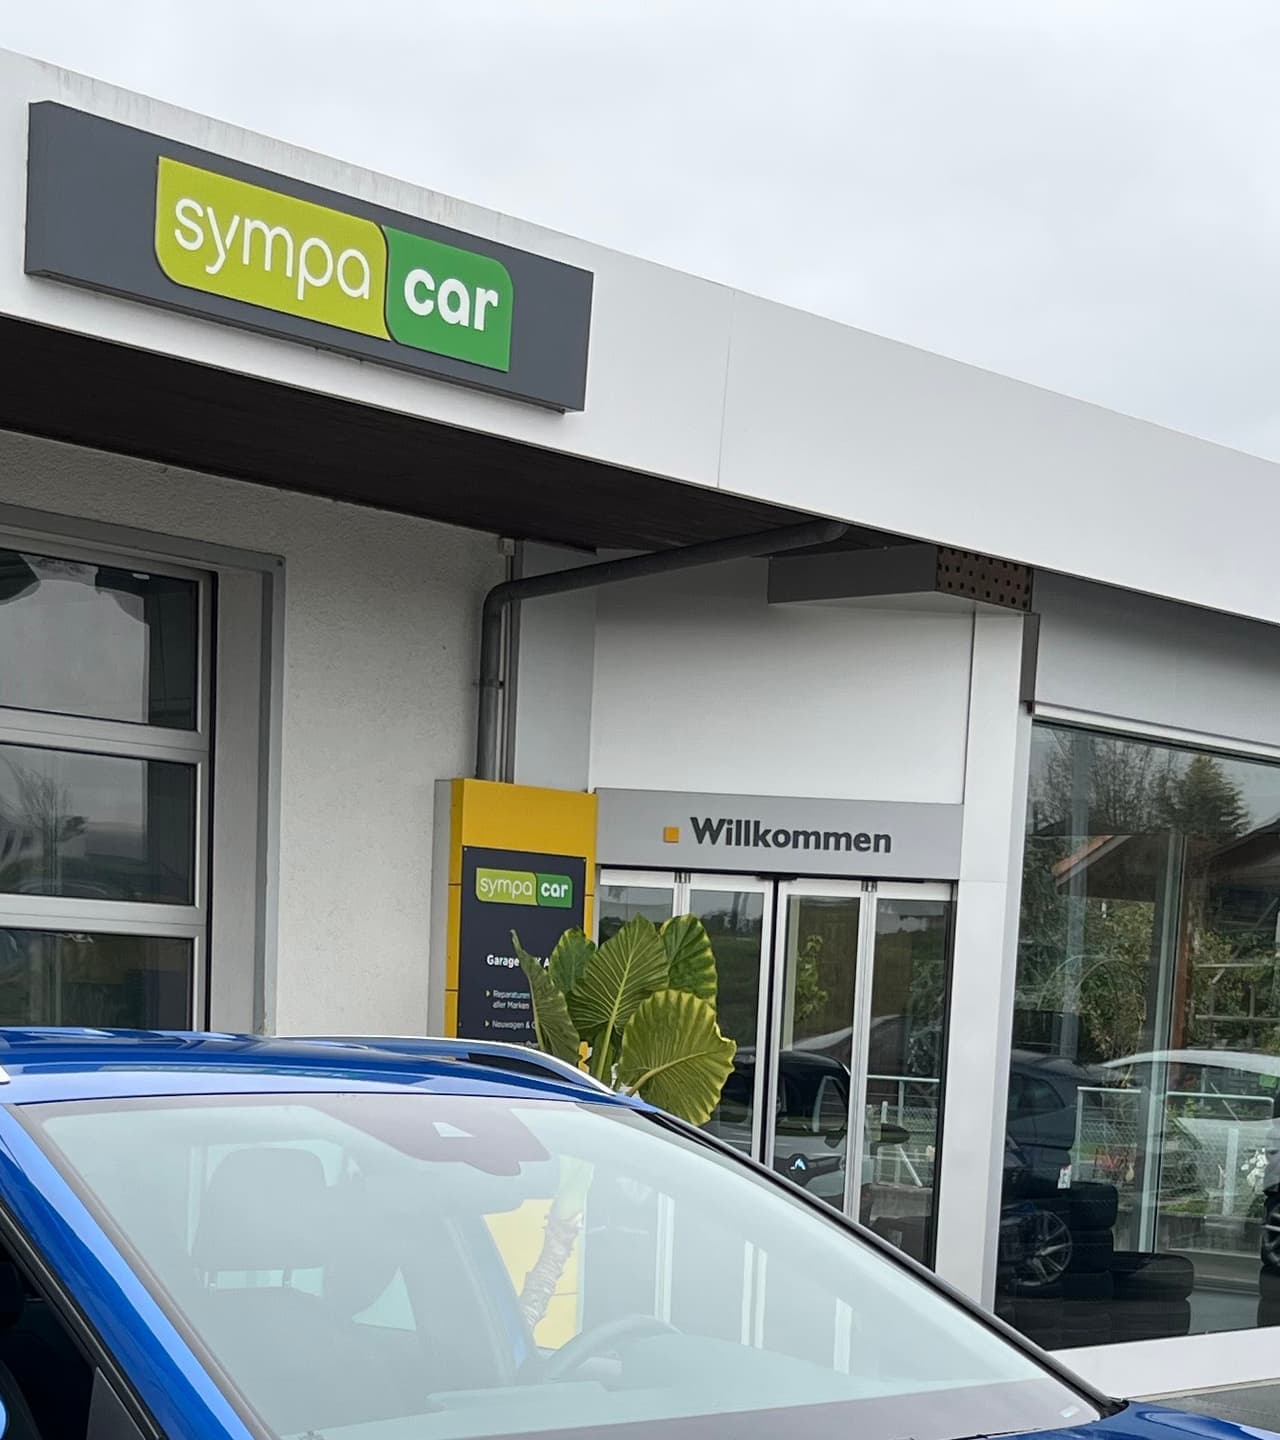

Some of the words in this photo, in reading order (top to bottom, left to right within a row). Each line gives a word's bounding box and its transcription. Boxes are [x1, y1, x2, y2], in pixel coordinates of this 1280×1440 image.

[173, 197, 371, 301] sympa
[403, 267, 499, 331] car
[689, 816, 892, 854] Willkommen
[480, 877, 533, 900] sympa
[540, 882, 569, 898] car
[486, 954, 520, 969] Garage
